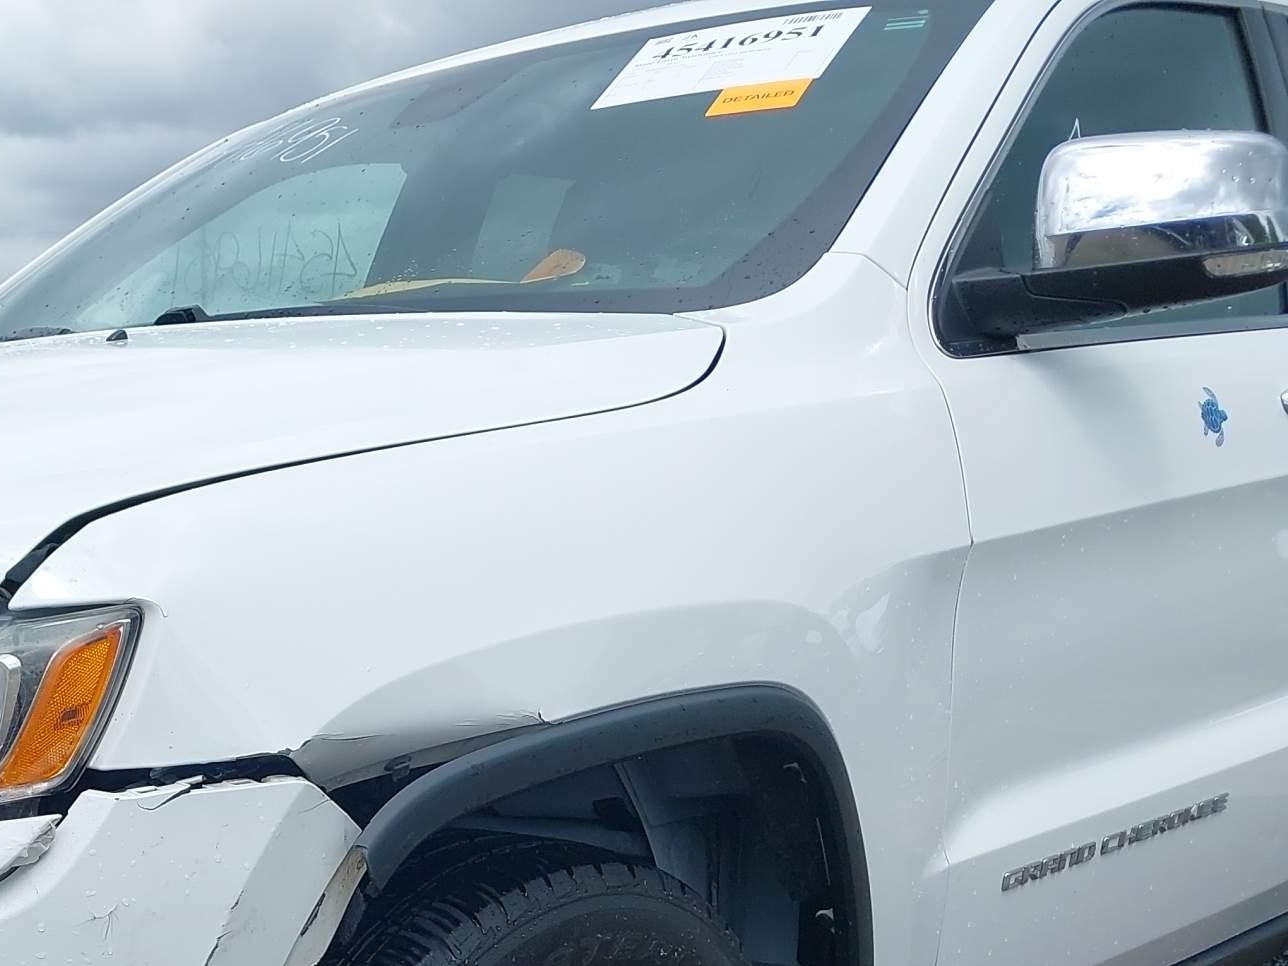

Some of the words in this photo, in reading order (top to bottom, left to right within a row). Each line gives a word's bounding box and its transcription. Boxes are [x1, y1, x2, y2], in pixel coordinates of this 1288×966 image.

[652, 25, 824, 60] 45416951
[721, 89, 796, 105] DETAILED
[1000, 840, 1097, 892] GRAND
[1099, 791, 1230, 856] CHEROKEE
